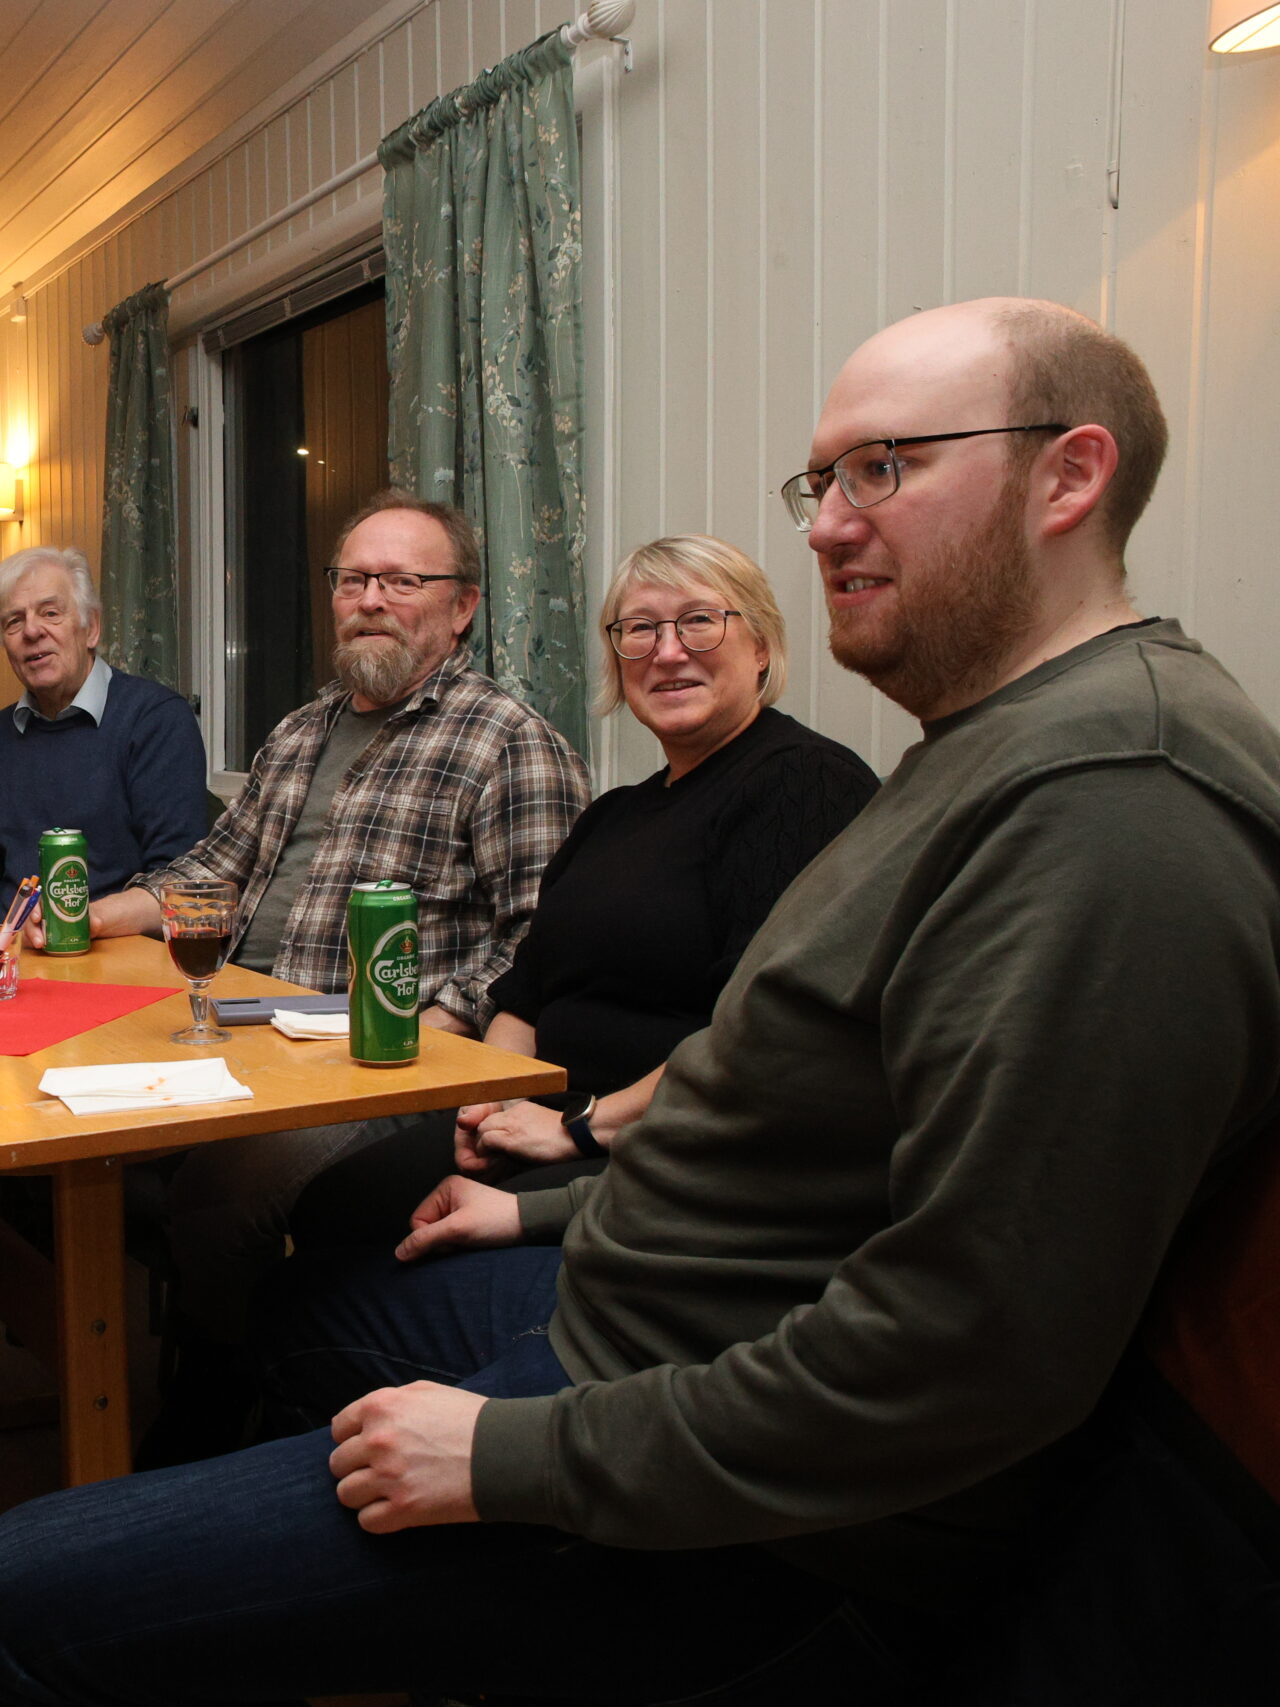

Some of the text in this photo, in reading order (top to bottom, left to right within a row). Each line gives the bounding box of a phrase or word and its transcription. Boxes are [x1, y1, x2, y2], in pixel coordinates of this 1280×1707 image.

[64, 898, 82, 908] Hof
[374, 960, 418, 983] Carlsbe
[397, 983, 417, 997] Hof
